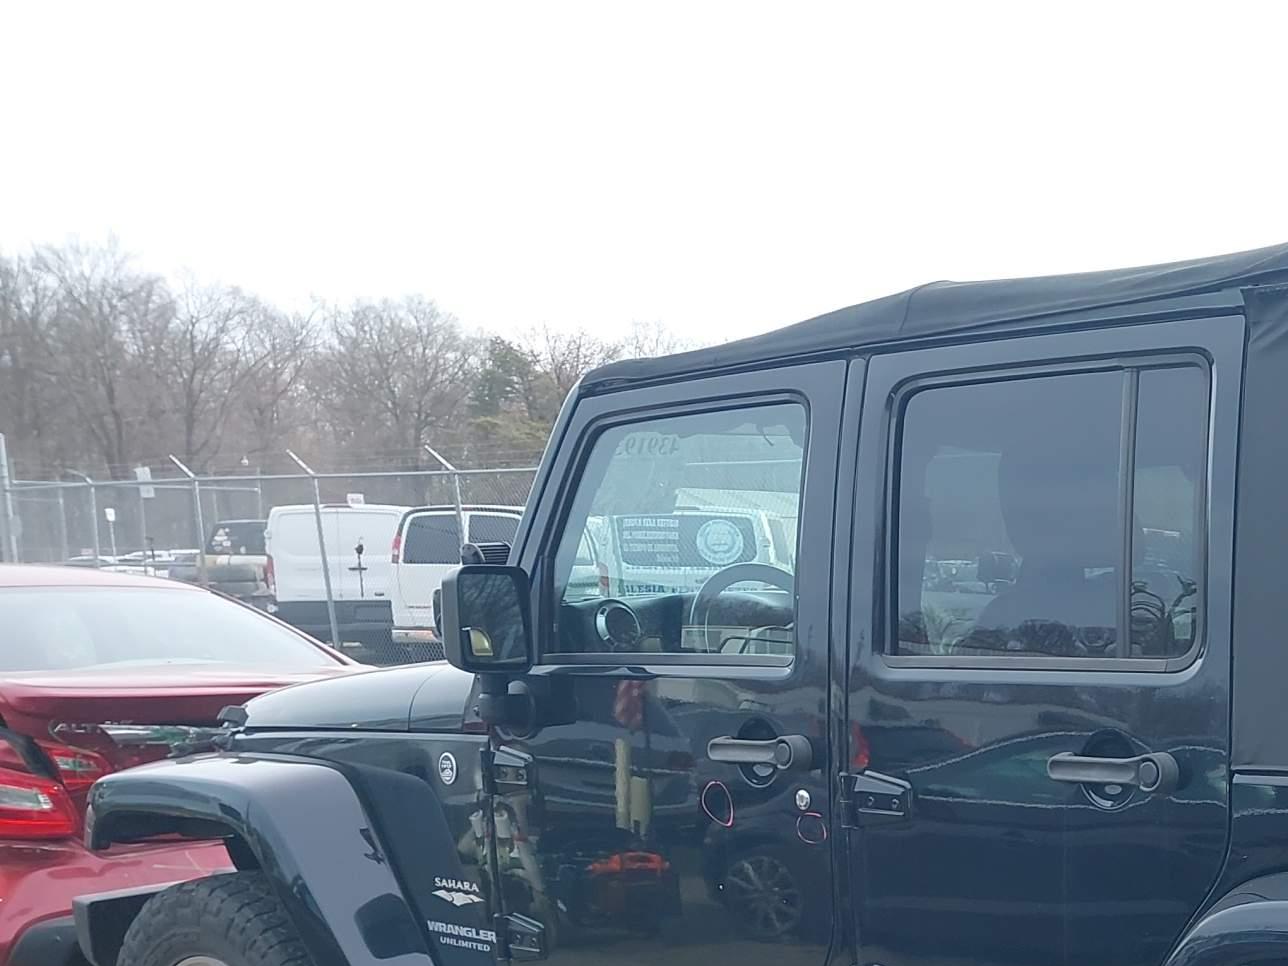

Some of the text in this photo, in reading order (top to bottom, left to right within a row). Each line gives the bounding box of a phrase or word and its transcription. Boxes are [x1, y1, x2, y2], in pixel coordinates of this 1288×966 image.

[434, 877, 480, 893] SAHARA
[427, 920, 497, 943] WRANGLER
[439, 936, 491, 952] UNLIMITED
